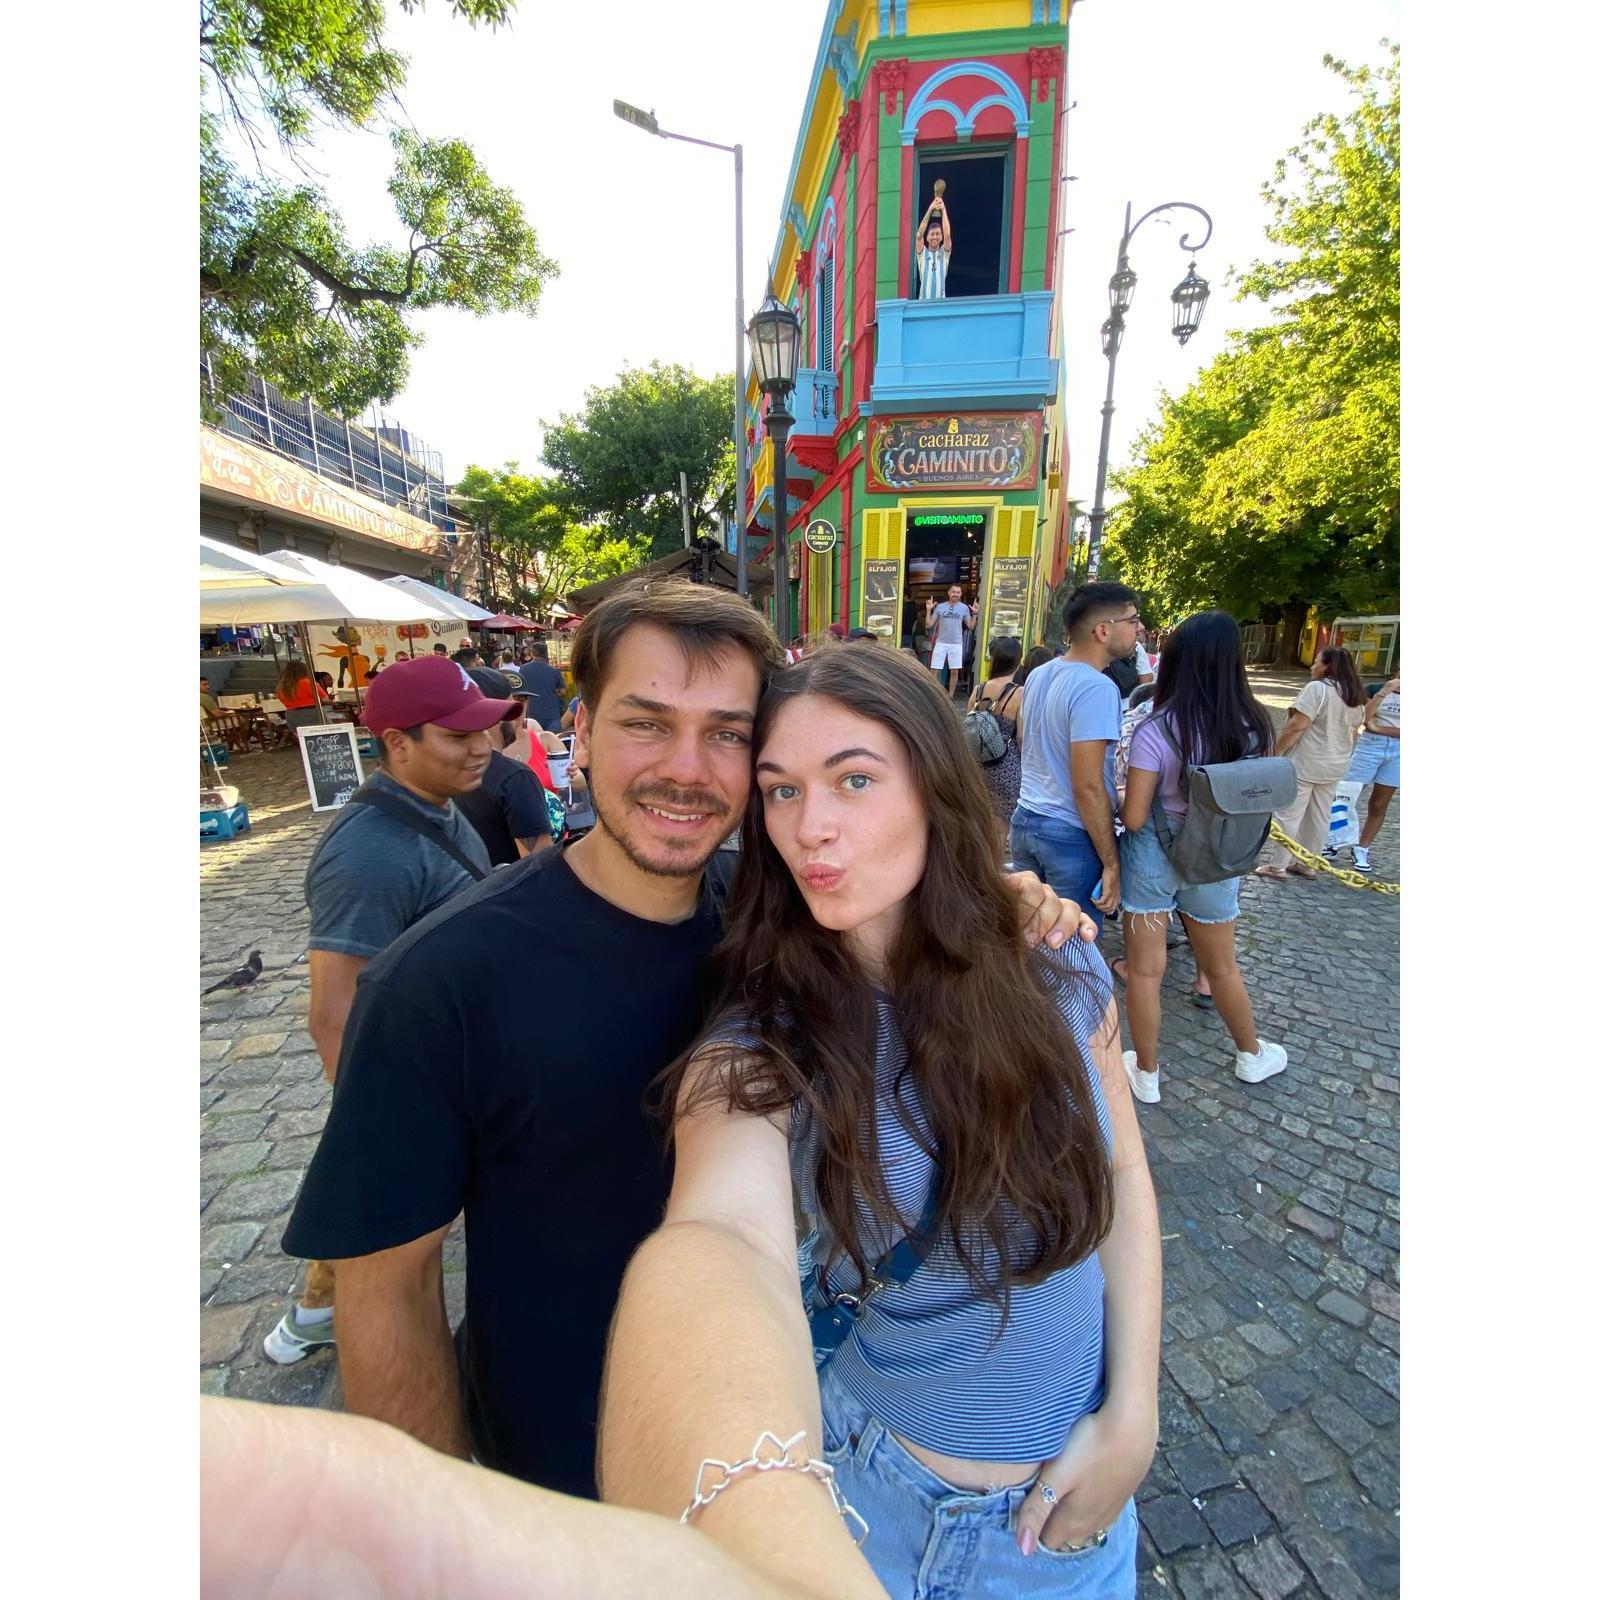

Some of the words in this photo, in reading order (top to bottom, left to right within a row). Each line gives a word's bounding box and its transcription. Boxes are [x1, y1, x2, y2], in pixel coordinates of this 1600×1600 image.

[898, 446, 1008, 476] CAMINITO
[923, 474, 954, 482] BUENOS
[296, 484, 380, 534] CAMINITO
[914, 514, 984, 526] @VISITCAMINITO
[431, 621, 464, 636] Quilmes
